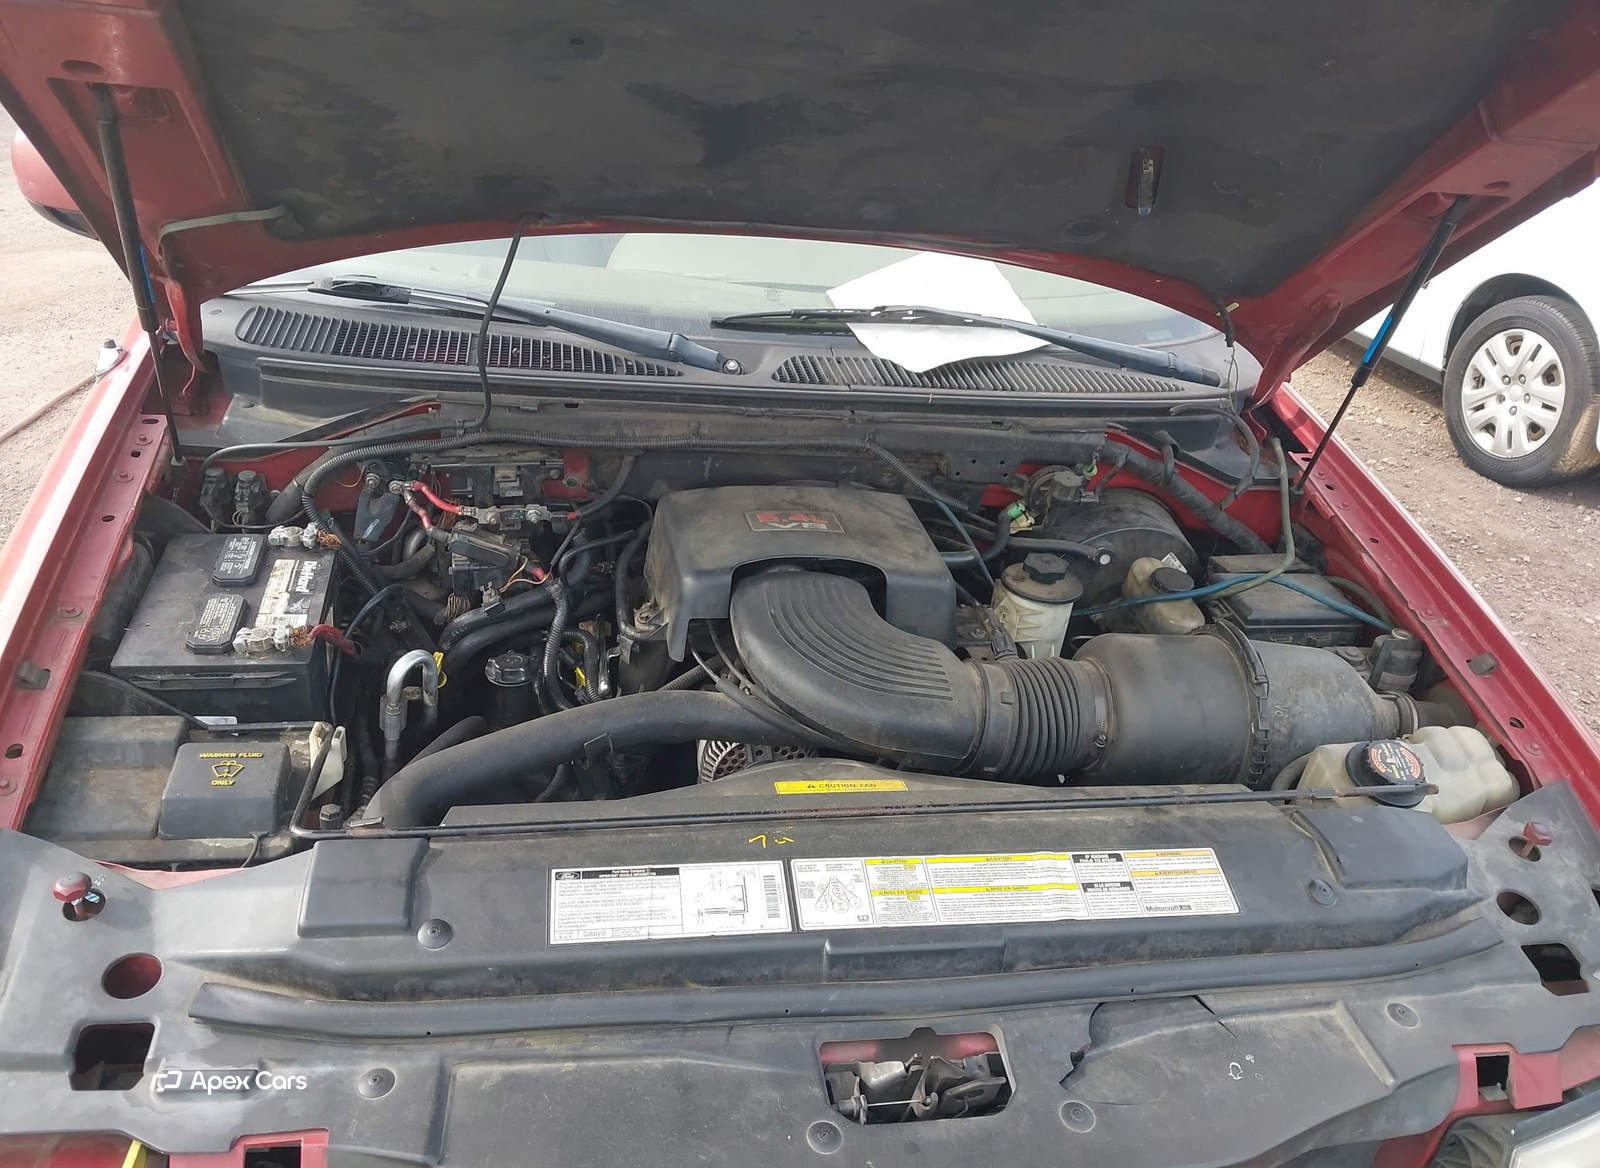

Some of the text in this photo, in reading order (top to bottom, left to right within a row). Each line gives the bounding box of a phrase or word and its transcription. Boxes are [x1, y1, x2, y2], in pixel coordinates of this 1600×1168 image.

[295, 560, 318, 593] DieHard
[1145, 904, 1180, 912] Motorcraft
[583, 930, 606, 938] Catalyst
